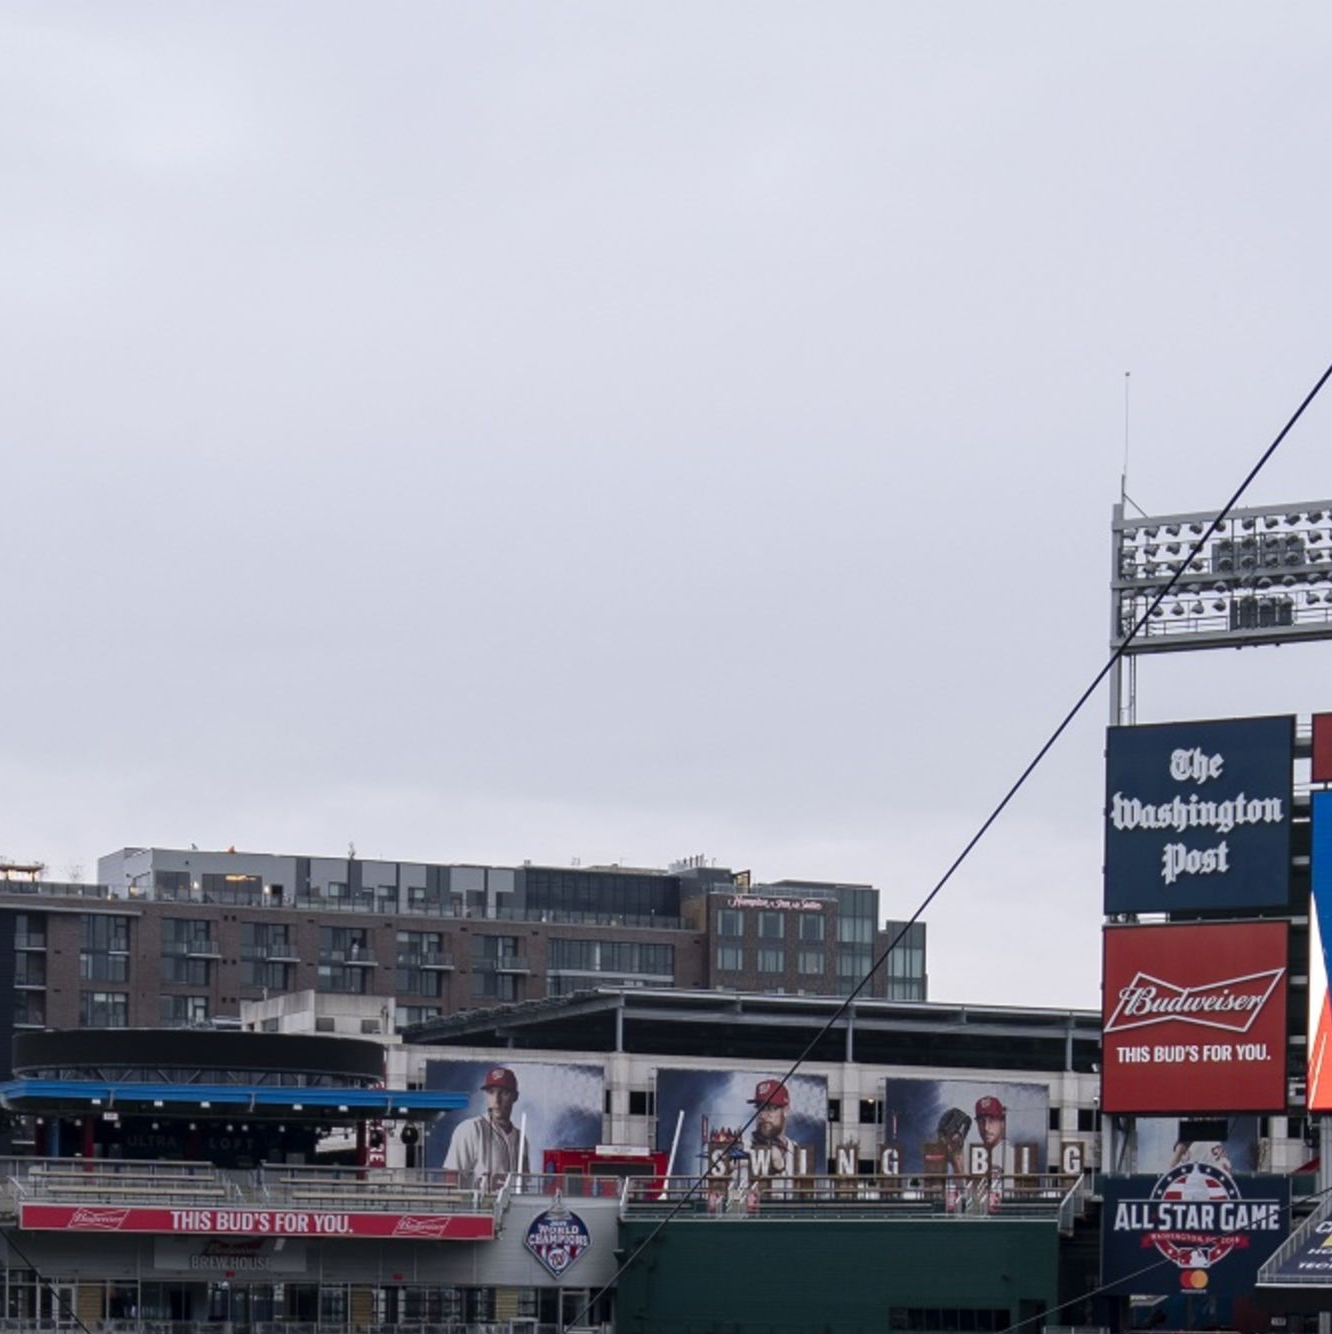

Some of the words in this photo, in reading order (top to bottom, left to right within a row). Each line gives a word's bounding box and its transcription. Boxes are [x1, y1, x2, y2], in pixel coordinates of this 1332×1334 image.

[1169, 748, 1225, 782] The
[1111, 792, 1285, 834] Washington
[1160, 840, 1230, 884] Post
[1119, 986, 1267, 1017] Budweiser
[1117, 1046, 1150, 1063] THIS
[1153, 1045, 1199, 1062] BUD'S
[1203, 1044, 1232, 1062] FOR
[1235, 1043, 1271, 1061] YOU.
[126, 1135, 177, 1148] ULTRA
[208, 1138, 254, 1150] LOFT
[170, 1210, 211, 1231] THIS
[215, 1211, 269, 1232] BUD'S
[274, 1213, 310, 1233] FOR
[313, 1214, 354, 1234] YOU.
[538, 1223, 579, 1234] WORLD
[1113, 1203, 1155, 1231] ALL
[1158, 1203, 1215, 1231] STAR
[1219, 1202, 1281, 1231] GAME
